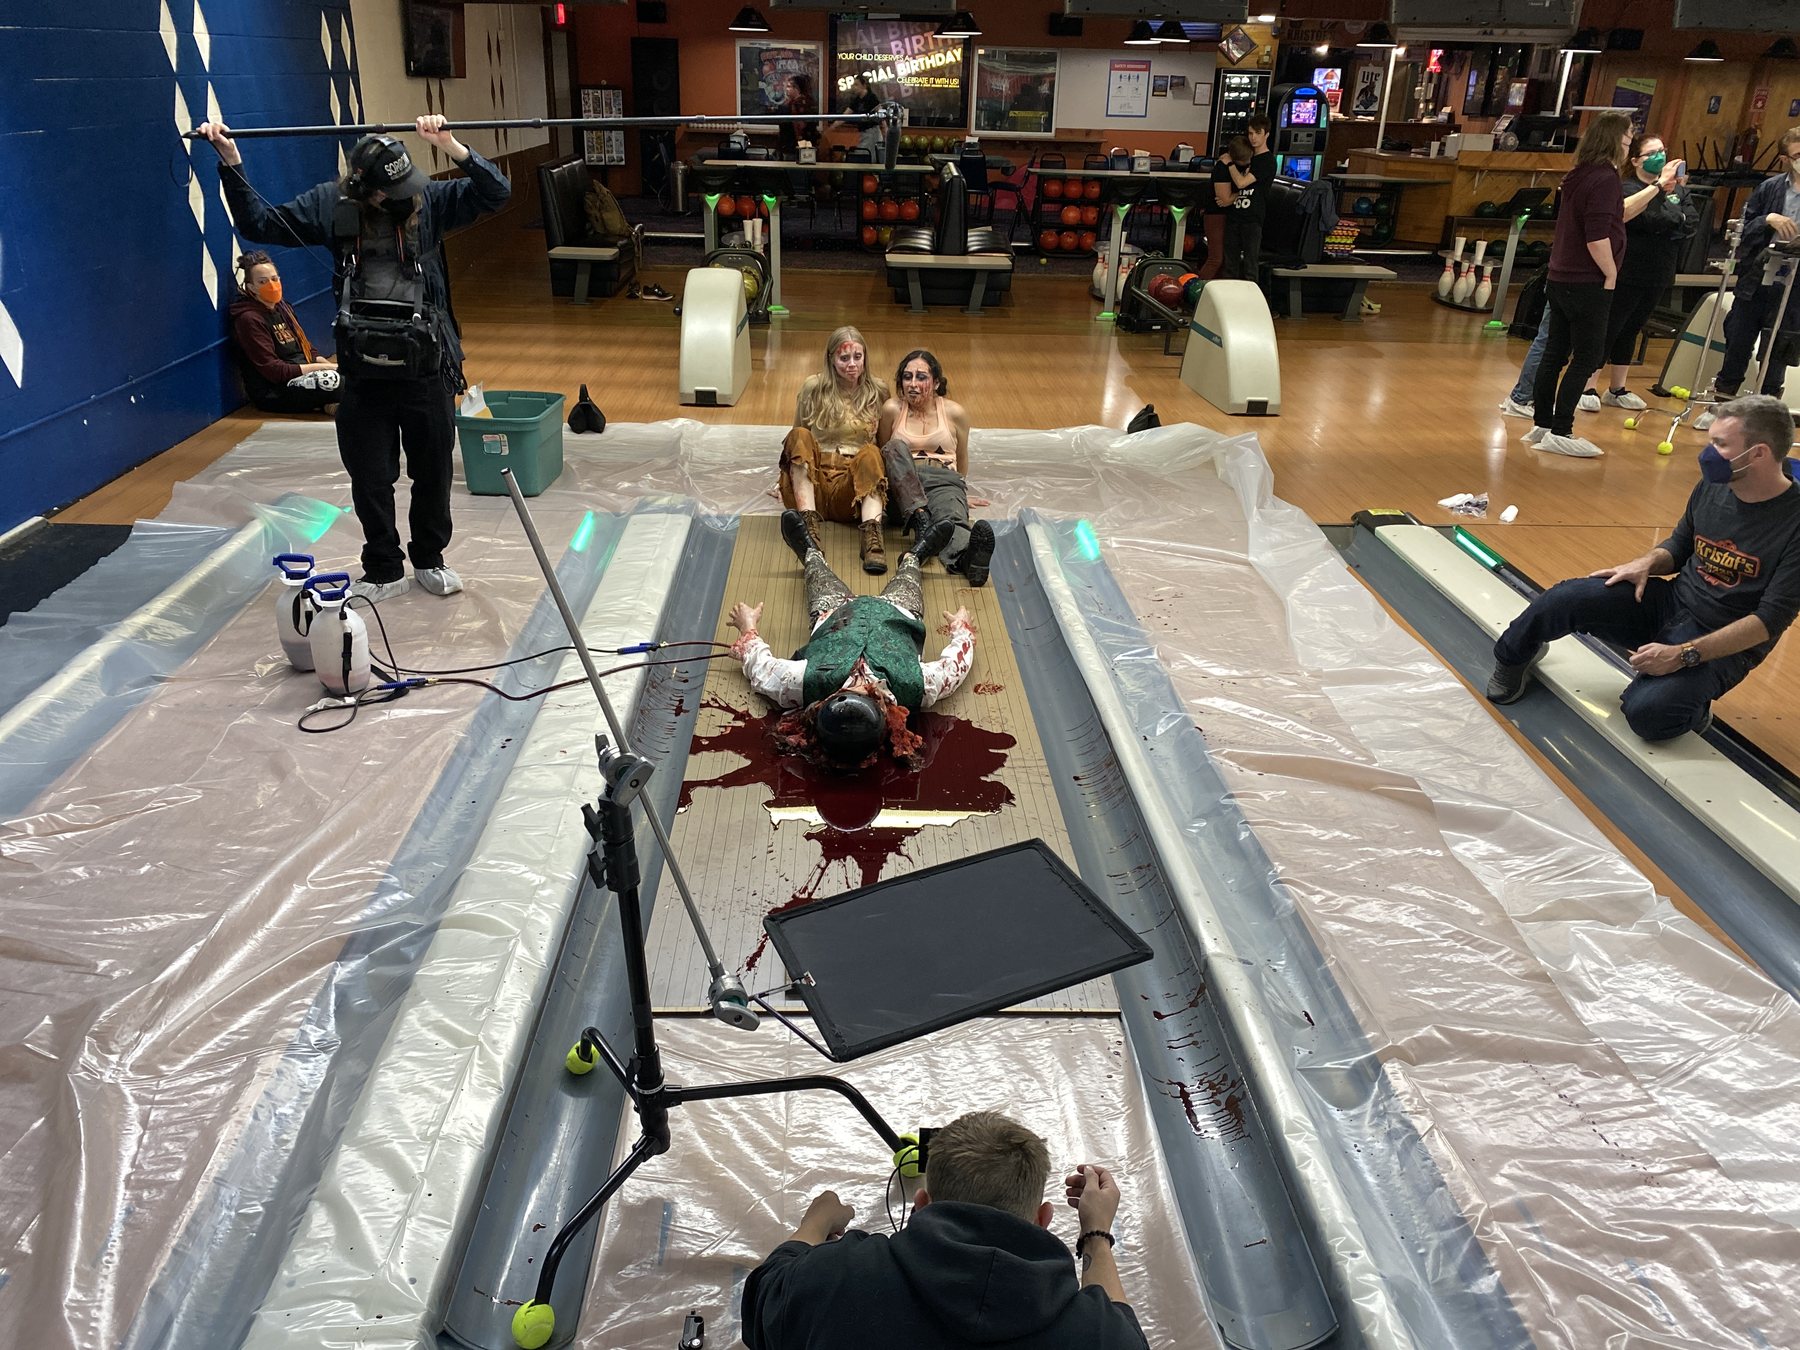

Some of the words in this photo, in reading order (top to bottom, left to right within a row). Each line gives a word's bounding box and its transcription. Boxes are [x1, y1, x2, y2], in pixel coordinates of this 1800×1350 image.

[874, 53, 904, 61] DESERVES
[837, 66, 895, 91] SPCIAL
[895, 48, 963, 77] BIRTHDAY
[1362, 71, 1381, 84] Lite
[1696, 540, 1755, 575] Kristof's
